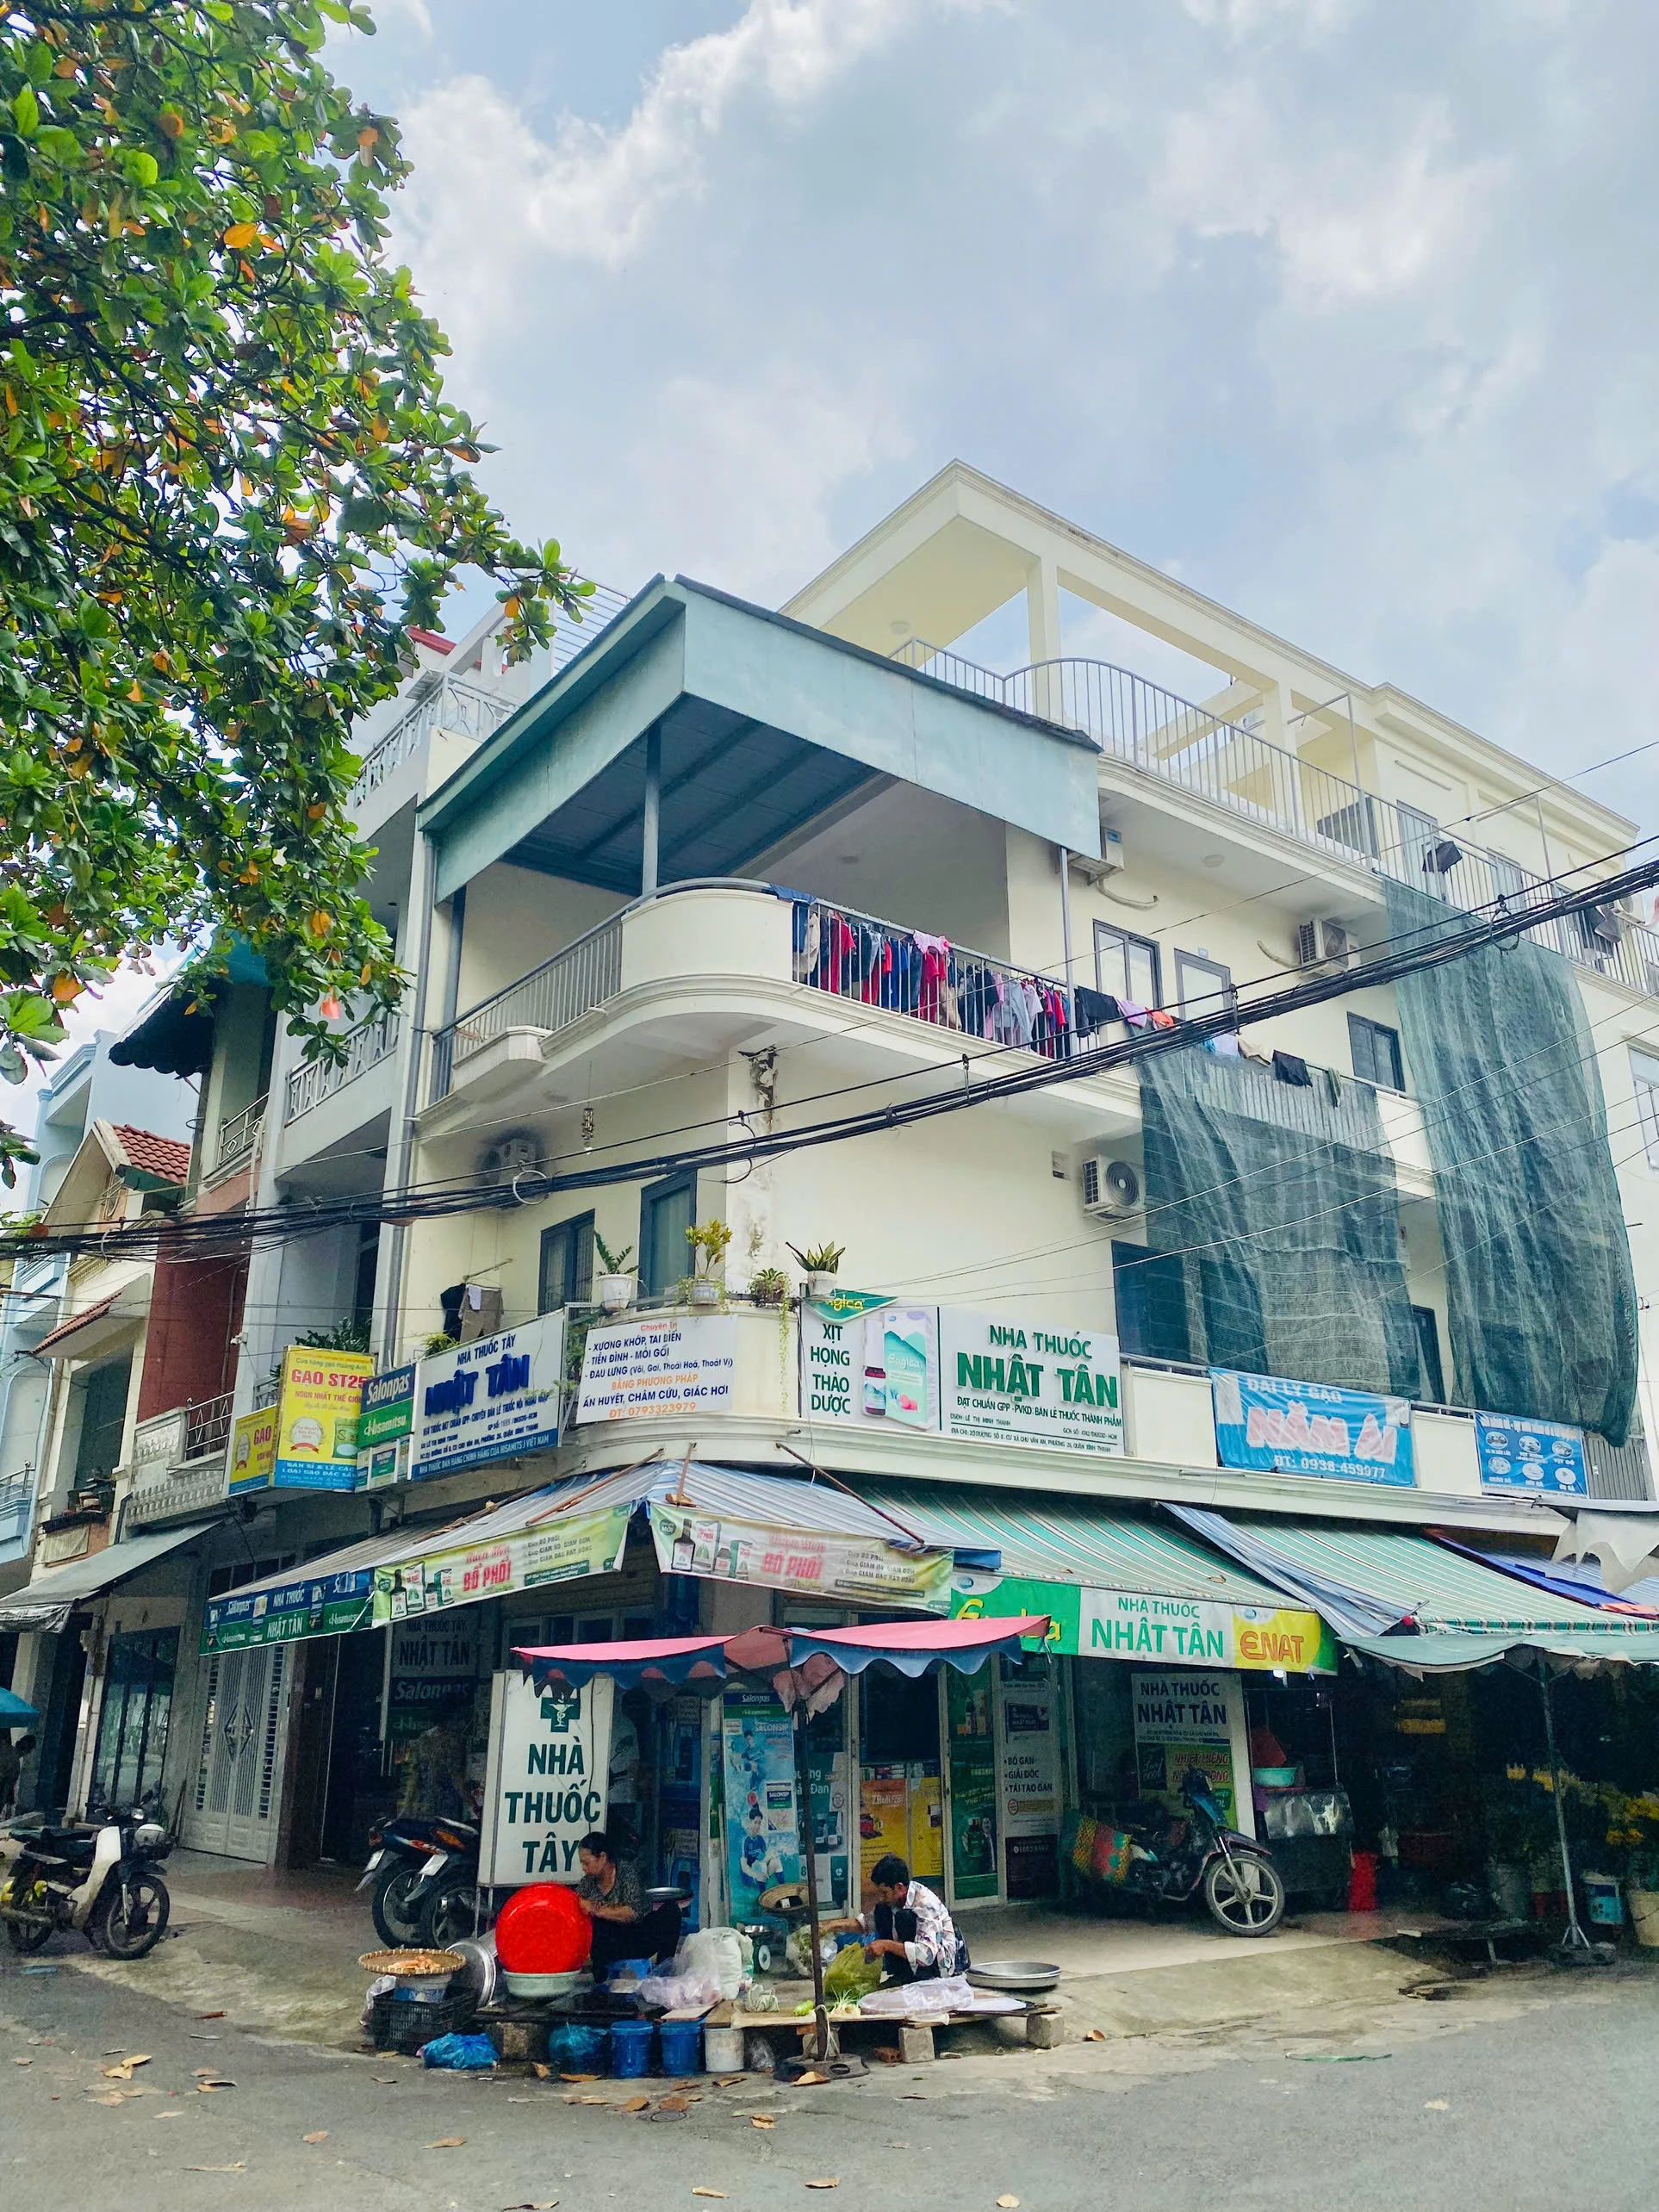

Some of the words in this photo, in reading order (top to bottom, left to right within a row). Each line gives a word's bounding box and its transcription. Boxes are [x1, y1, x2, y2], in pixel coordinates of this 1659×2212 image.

[593, 1339, 622, 1351] XƯƠNG
[649, 1334, 662, 1344] TAI
[823, 1323, 843, 1344] XỊT
[457, 1347, 471, 1365] NHÀ
[475, 1337, 499, 1360] THUỐC
[502, 1333, 516, 1351] TÂY
[811, 1346, 850, 1367] HỌNG
[485, 1353, 531, 1398] TÂN
[589, 1368, 606, 1379] ĐAU
[607, 1365, 628, 1376] LƯNG
[637, 1376, 673, 1388] PHƯƠNG
[675, 1372, 699, 1384] PHÁP
[812, 1371, 849, 1393] THẢO
[956, 1351, 1044, 1402] NHẬT
[1056, 1364, 1119, 1408] TÂN
[366, 1373, 410, 1406] Salonpas
[628, 1389, 656, 1402] CHÂM
[683, 1385, 708, 1397] GIÁC
[711, 1384, 729, 1396] HƠI
[628, 1401, 697, 1417] 0793323979
[811, 1395, 851, 1417] DƯỢC
[363, 1414, 407, 1437] Hisamitsu
[482, 1556, 511, 1587] PHỔI
[1118, 1596, 1149, 1614] NHÀ
[1152, 1600, 1200, 1619] THUỐC
[267, 1616, 287, 1641] NHẬT
[288, 1613, 304, 1635] TÂN
[1173, 1621, 1224, 1658] TÂN
[1240, 1631, 1304, 1663] ENAT
[399, 1635, 437, 1671] NHẬT
[442, 1635, 470, 1666] TÂN
[742, 1693, 771, 1704] Salonpas
[1171, 1678, 1221, 1696] THUỐC
[1138, 1699, 1185, 1729] NHẬT
[1189, 1699, 1227, 1724] TÂN
[528, 1736, 585, 1775] NHÀ
[1019, 1755, 1035, 1765] GAN
[1037, 1782, 1053, 1793] GAN
[505, 1780, 601, 1824] THUỐC
[522, 1831, 580, 1873] TÂY
